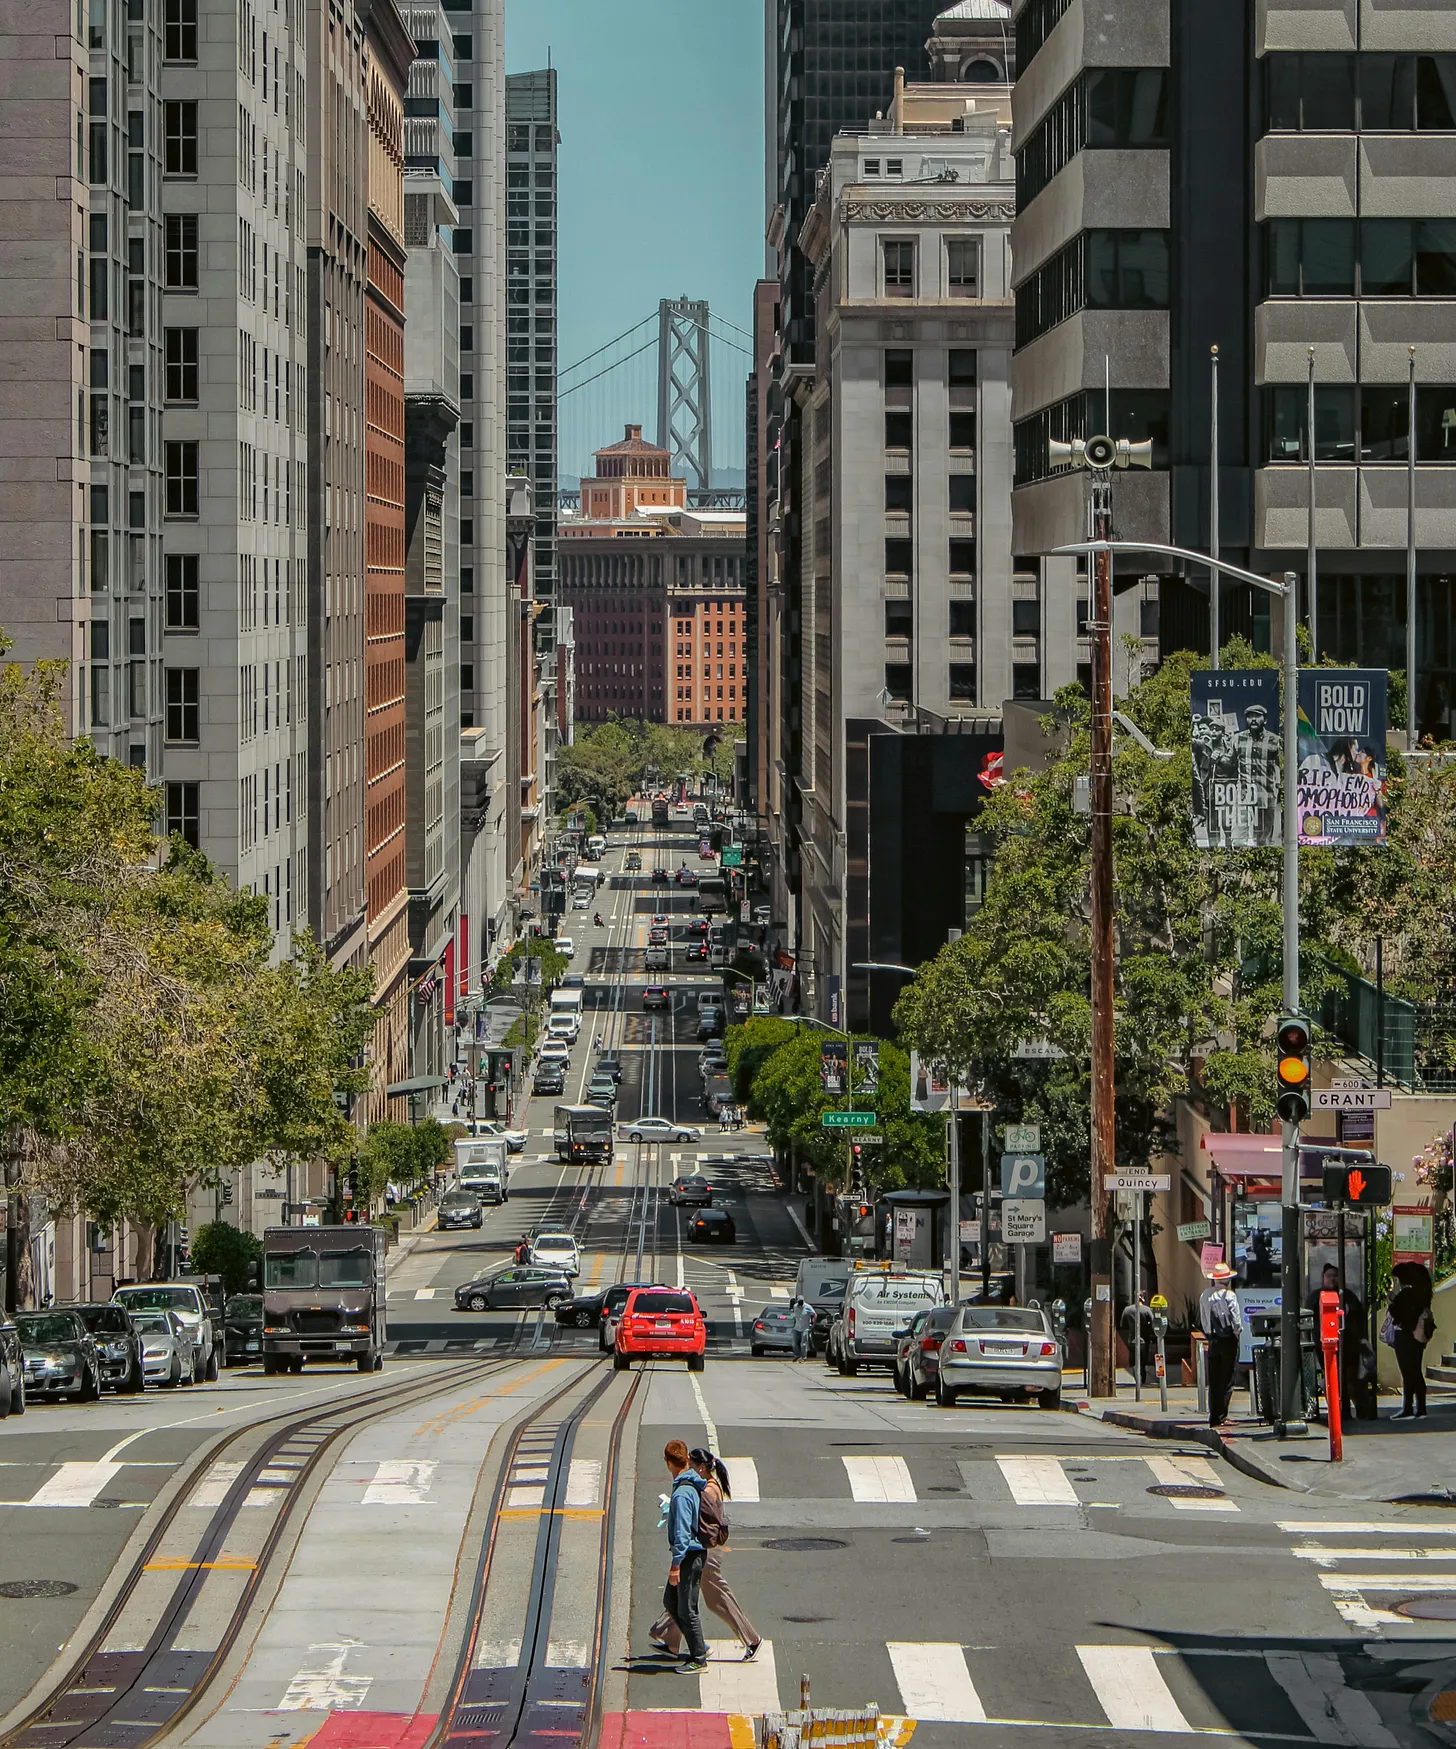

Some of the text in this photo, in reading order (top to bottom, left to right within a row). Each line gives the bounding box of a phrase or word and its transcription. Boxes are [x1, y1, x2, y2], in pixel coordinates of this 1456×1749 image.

[1207, 679, 1262, 688] SFSU.EDU
[1320, 685, 1365, 707] BOLD
[1320, 708, 1363, 732] NOW
[1345, 776, 1370, 794] END
[1214, 783, 1258, 805] BOLD
[1297, 787, 1370, 810] OMOPHOBIA
[1214, 806, 1259, 827] THEN
[1326, 818, 1378, 826] SAN FRANCISCO
[1342, 1080, 1359, 1088] 600
[1319, 1094, 1376, 1105] GRANT
[828, 1115, 869, 1124] Kearny
[1117, 1178, 1158, 1189] Quincy
[1017, 1215, 1043, 1223] Mary's
[1007, 1222, 1034, 1230] Square
[1007, 1230, 1035, 1238] Garage
[1180, 1228, 1209, 1237] ENTRANCE
[876, 1290, 931, 1301] Air Systems
